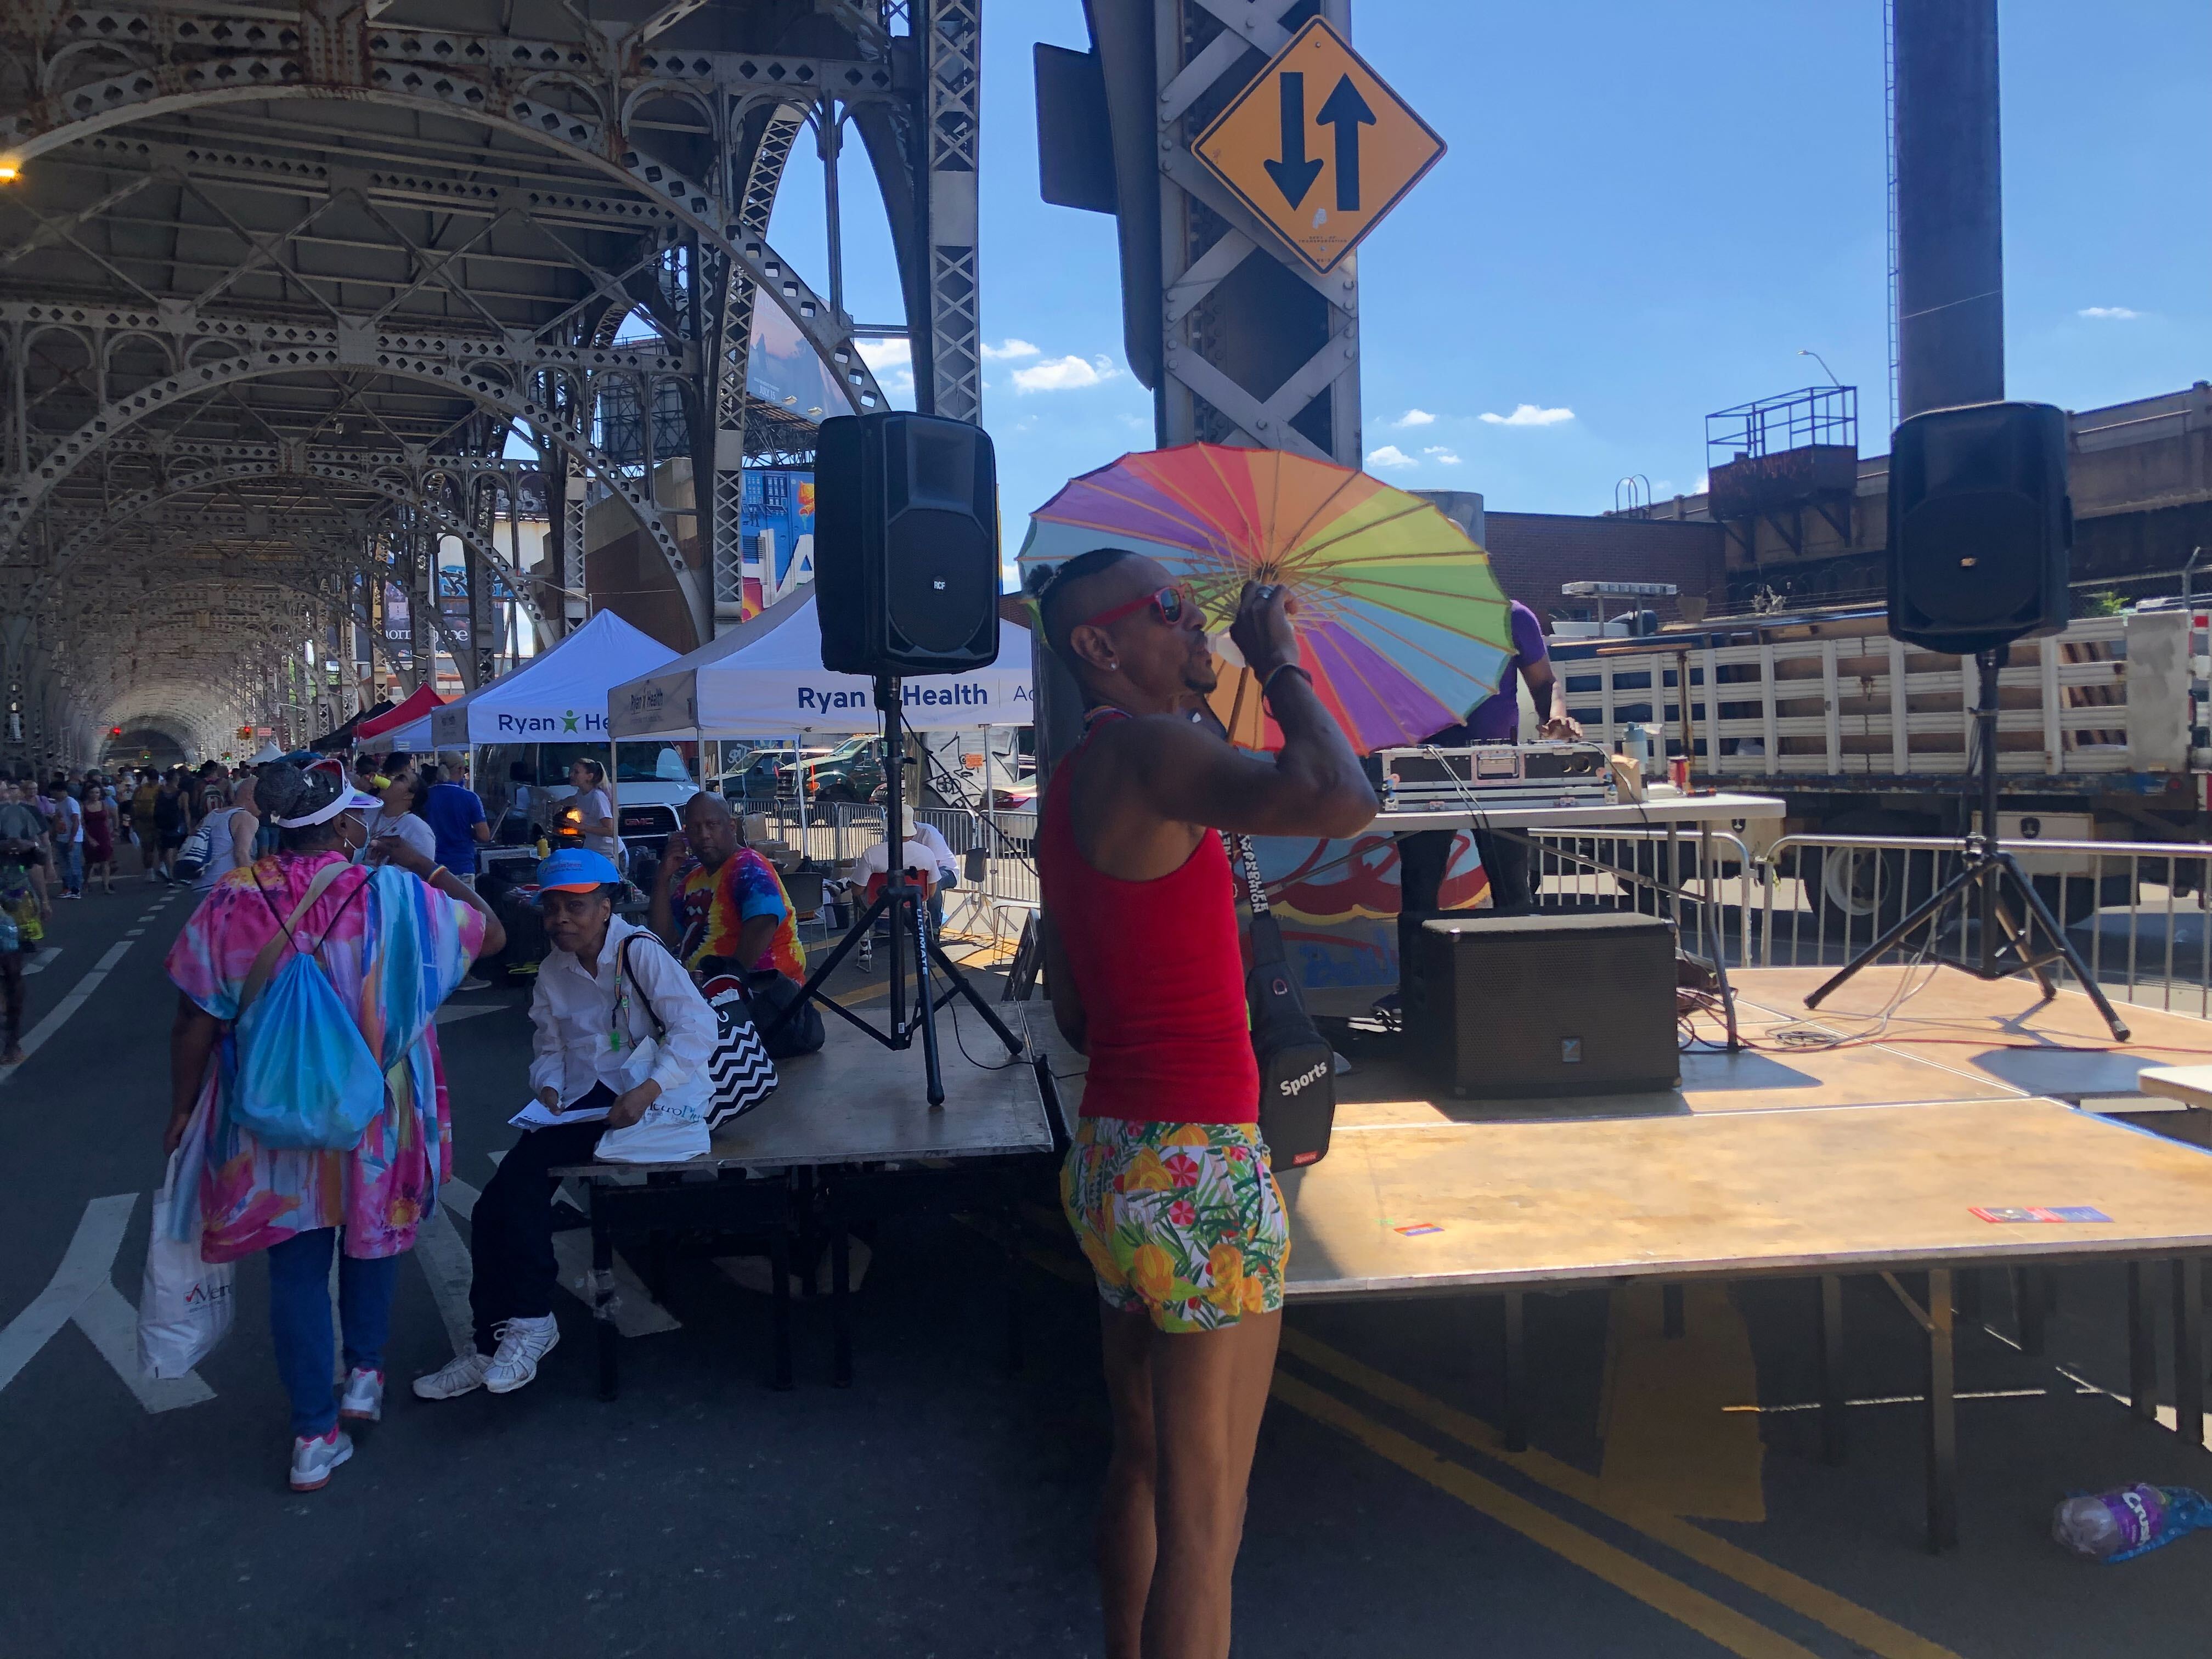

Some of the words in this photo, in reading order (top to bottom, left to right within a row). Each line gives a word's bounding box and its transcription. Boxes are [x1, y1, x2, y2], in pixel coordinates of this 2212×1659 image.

[759, 385, 769, 397] JULY
[934, 581, 945, 590] RCF
[647, 688, 663, 707] Health
[798, 686, 866, 714] Ryan
[903, 684, 988, 706] Health
[498, 714, 555, 735] Ryan
[917, 909, 928, 975] ULTIMATE
[1280, 1062, 1328, 1096] Sports
